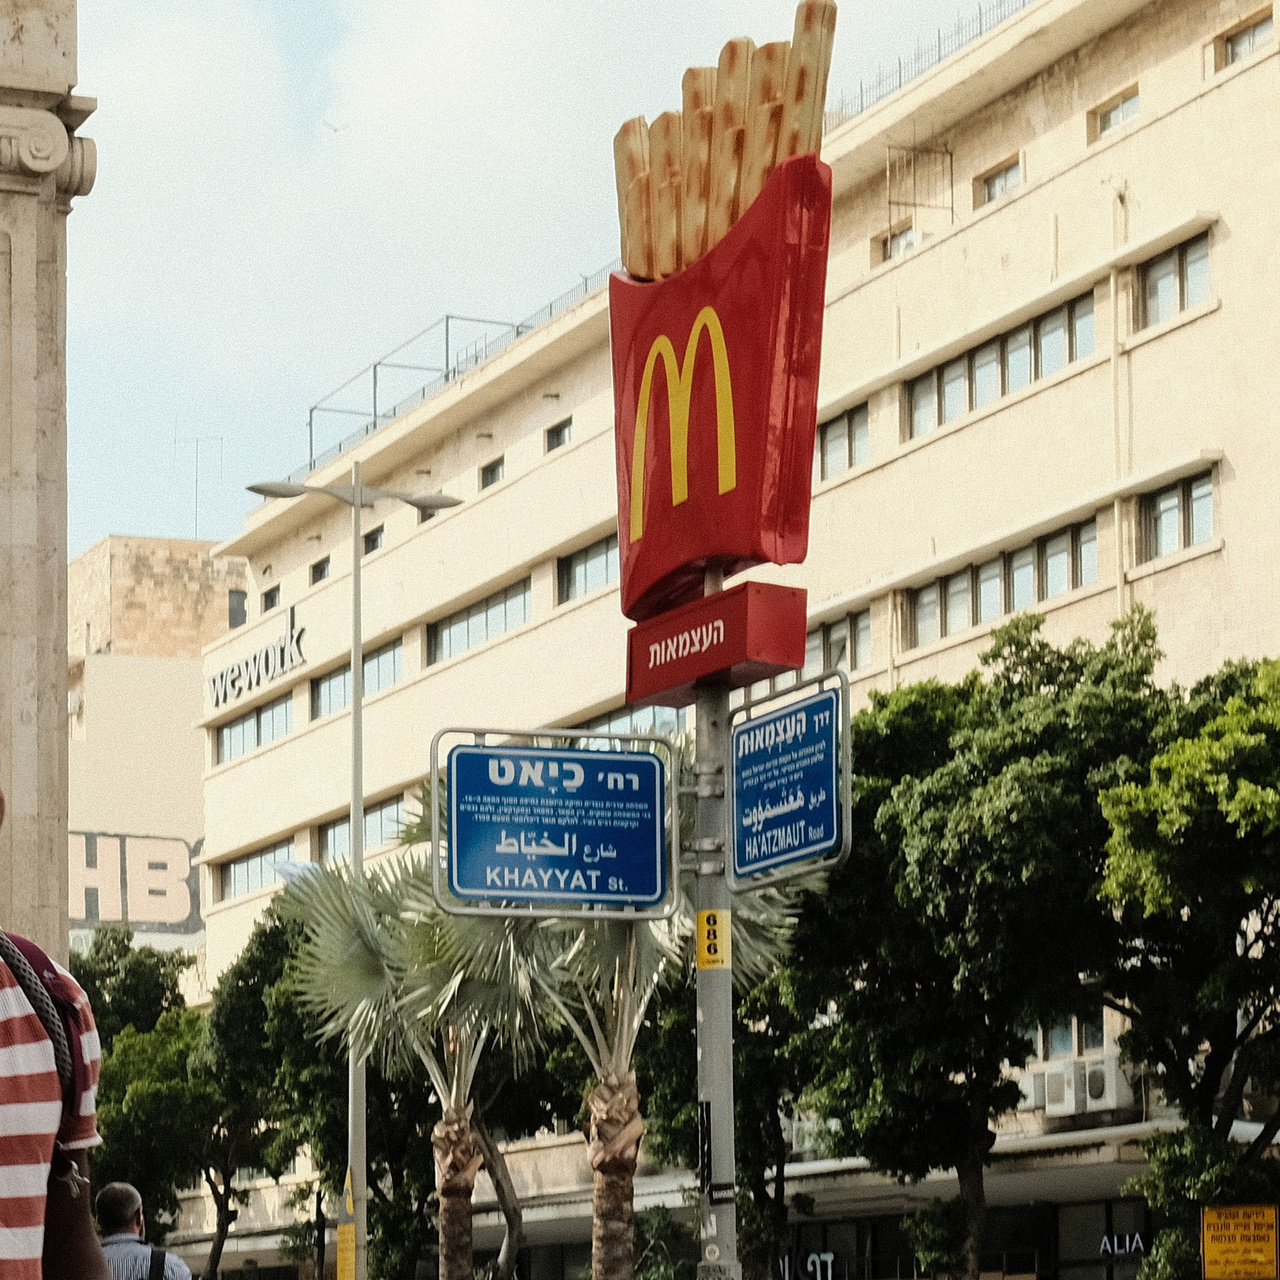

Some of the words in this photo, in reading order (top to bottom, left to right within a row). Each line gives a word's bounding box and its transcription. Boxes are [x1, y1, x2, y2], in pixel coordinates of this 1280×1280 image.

[207, 606, 305, 708] wework
[648, 619, 725, 669] העצמאות
[583, 843, 617, 863] شارع
[745, 819, 806, 862] HA'ATZMAUT
[808, 823, 824, 843] Road
[68, 833, 205, 924] HB
[486, 866, 601, 891] KHAYYAT
[608, 876, 628, 892] St.
[1100, 1232, 1145, 1254] ALIA
